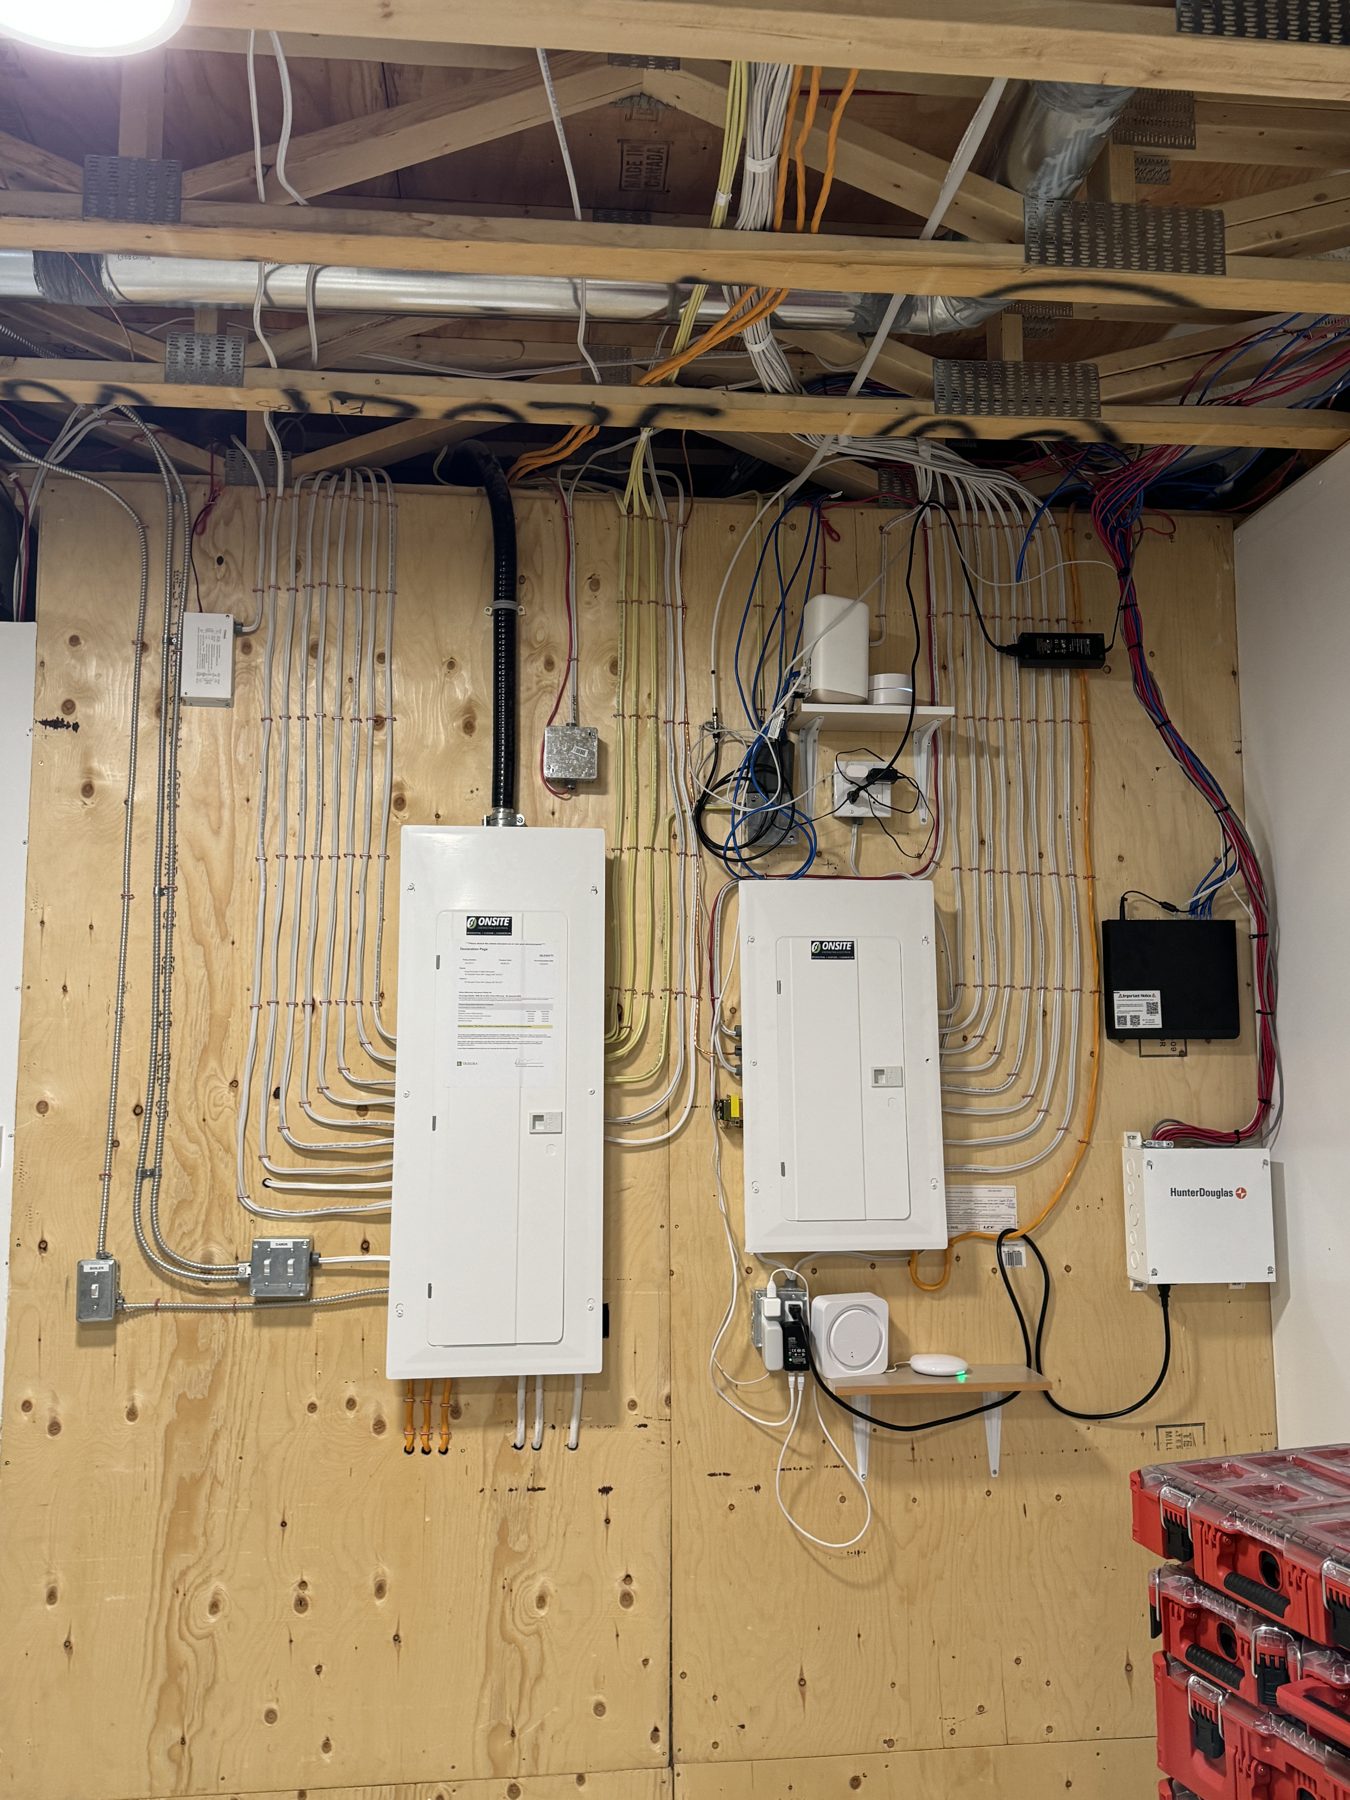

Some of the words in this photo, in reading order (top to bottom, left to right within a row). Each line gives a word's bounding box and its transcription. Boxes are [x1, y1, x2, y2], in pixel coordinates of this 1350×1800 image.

[644, 147, 664, 188] CANADA
[624, 160, 642, 189] MADE
[478, 917, 510, 926] ONSITE
[822, 941, 852, 950] ONSITE
[1170, 1187, 1234, 1200] HunterDouglas
